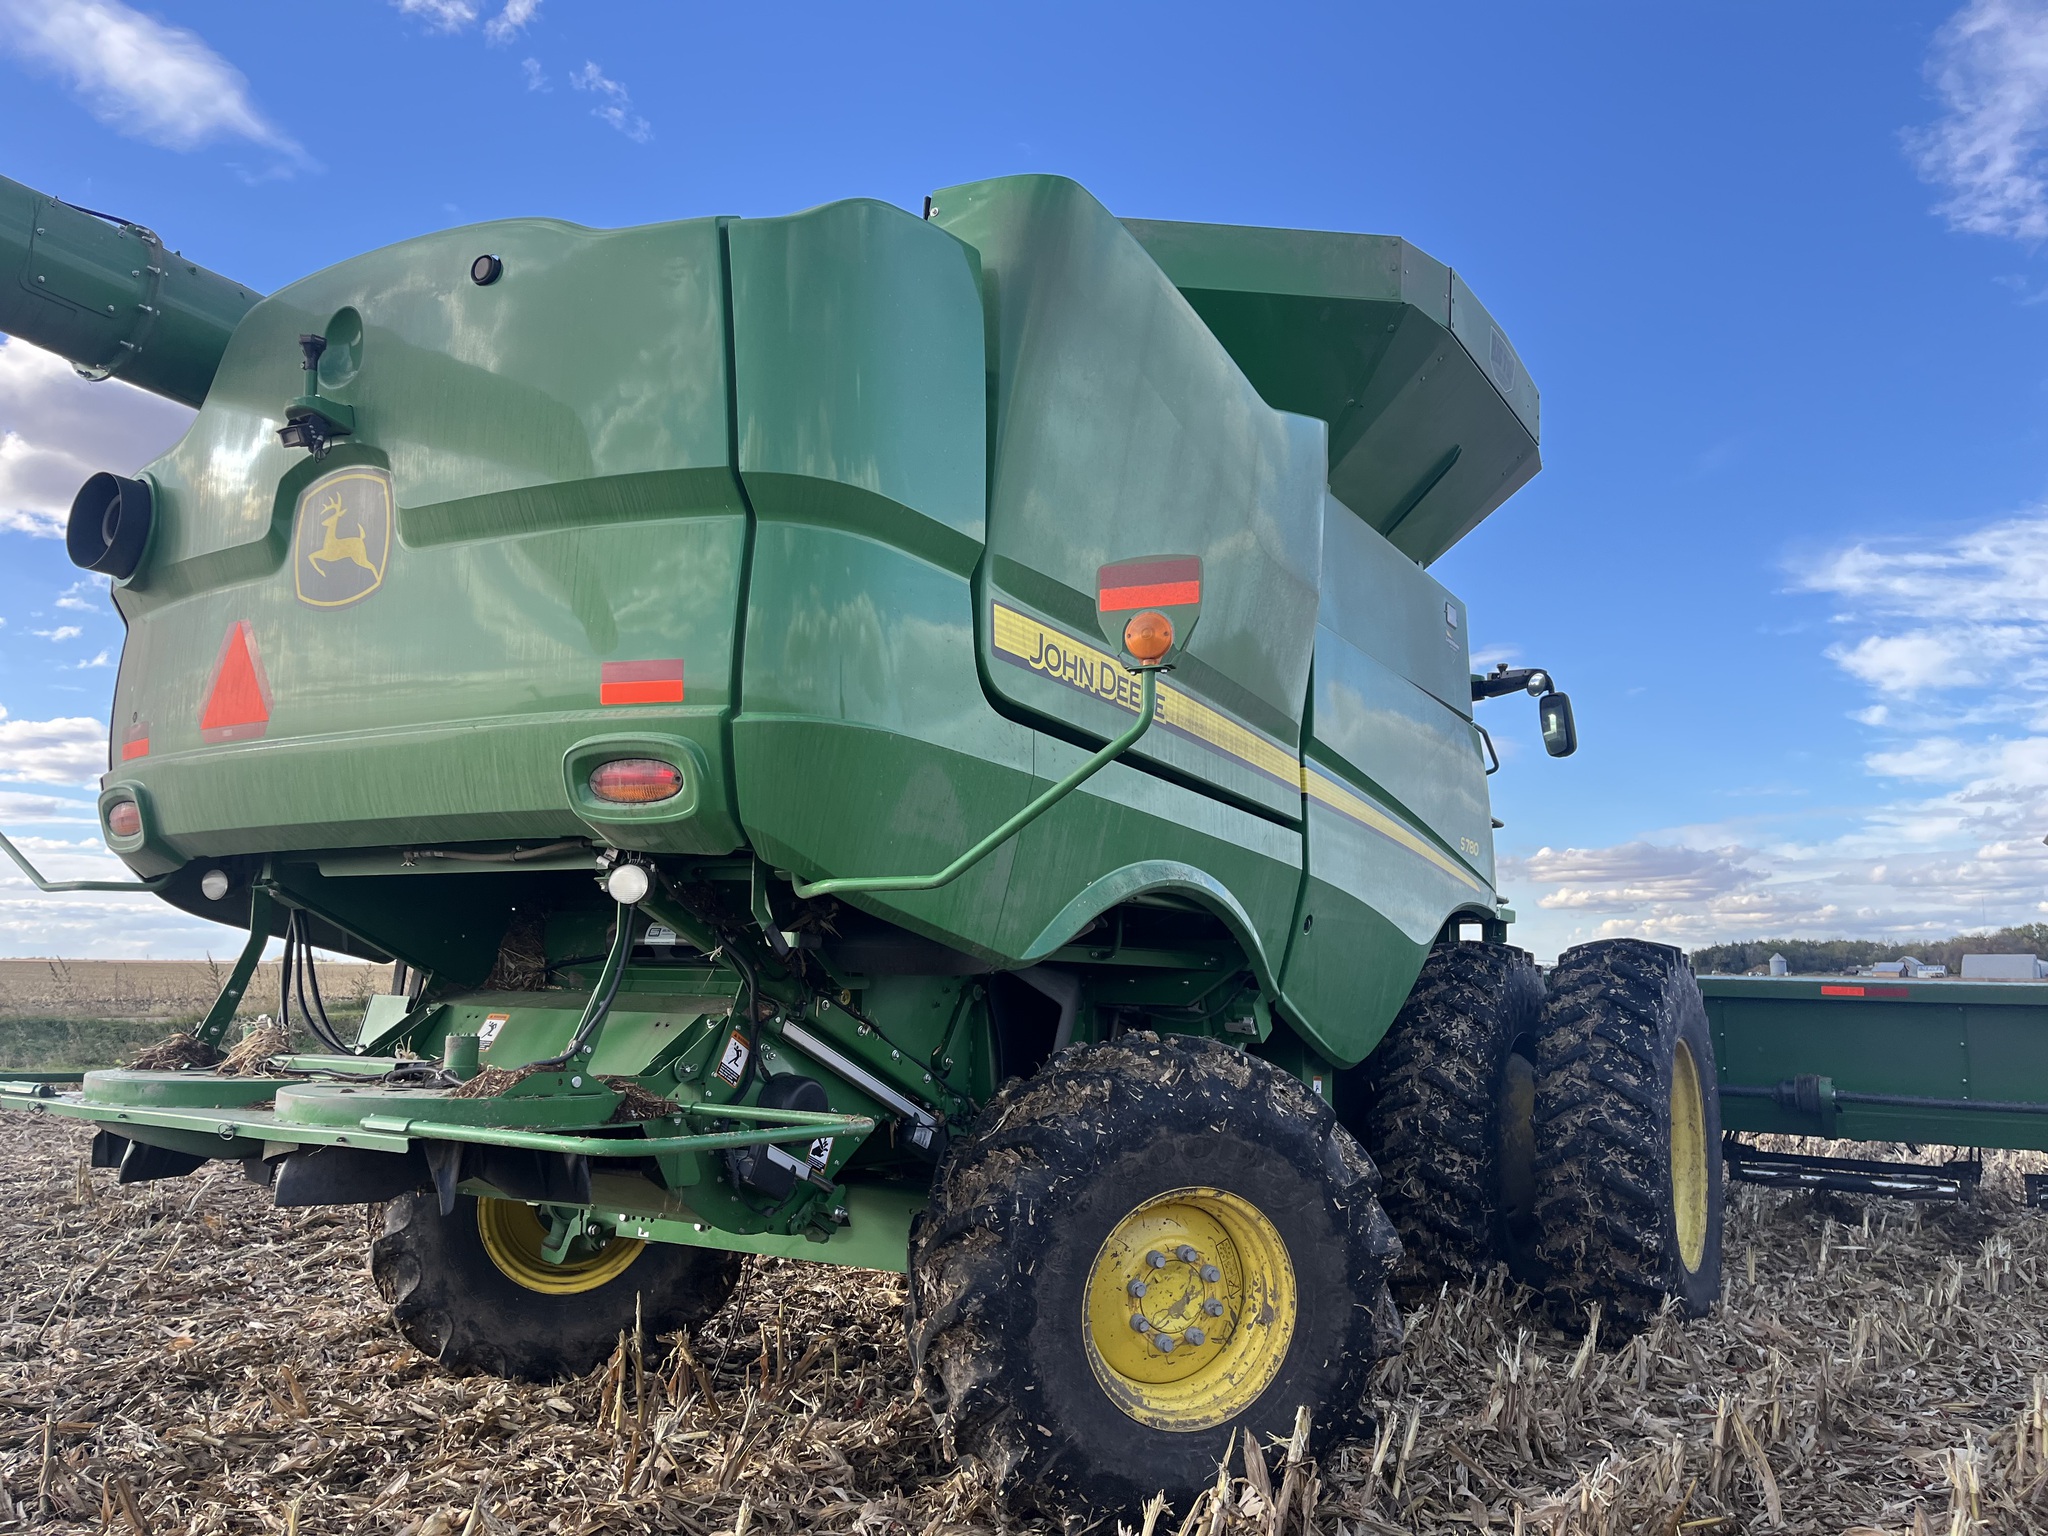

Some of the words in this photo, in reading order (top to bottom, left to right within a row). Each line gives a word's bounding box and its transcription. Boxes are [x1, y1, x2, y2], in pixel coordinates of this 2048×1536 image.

[1029, 632, 1095, 690] JOHN
[1099, 661, 1166, 720] DEEE
[1460, 836, 1479, 857] S780
